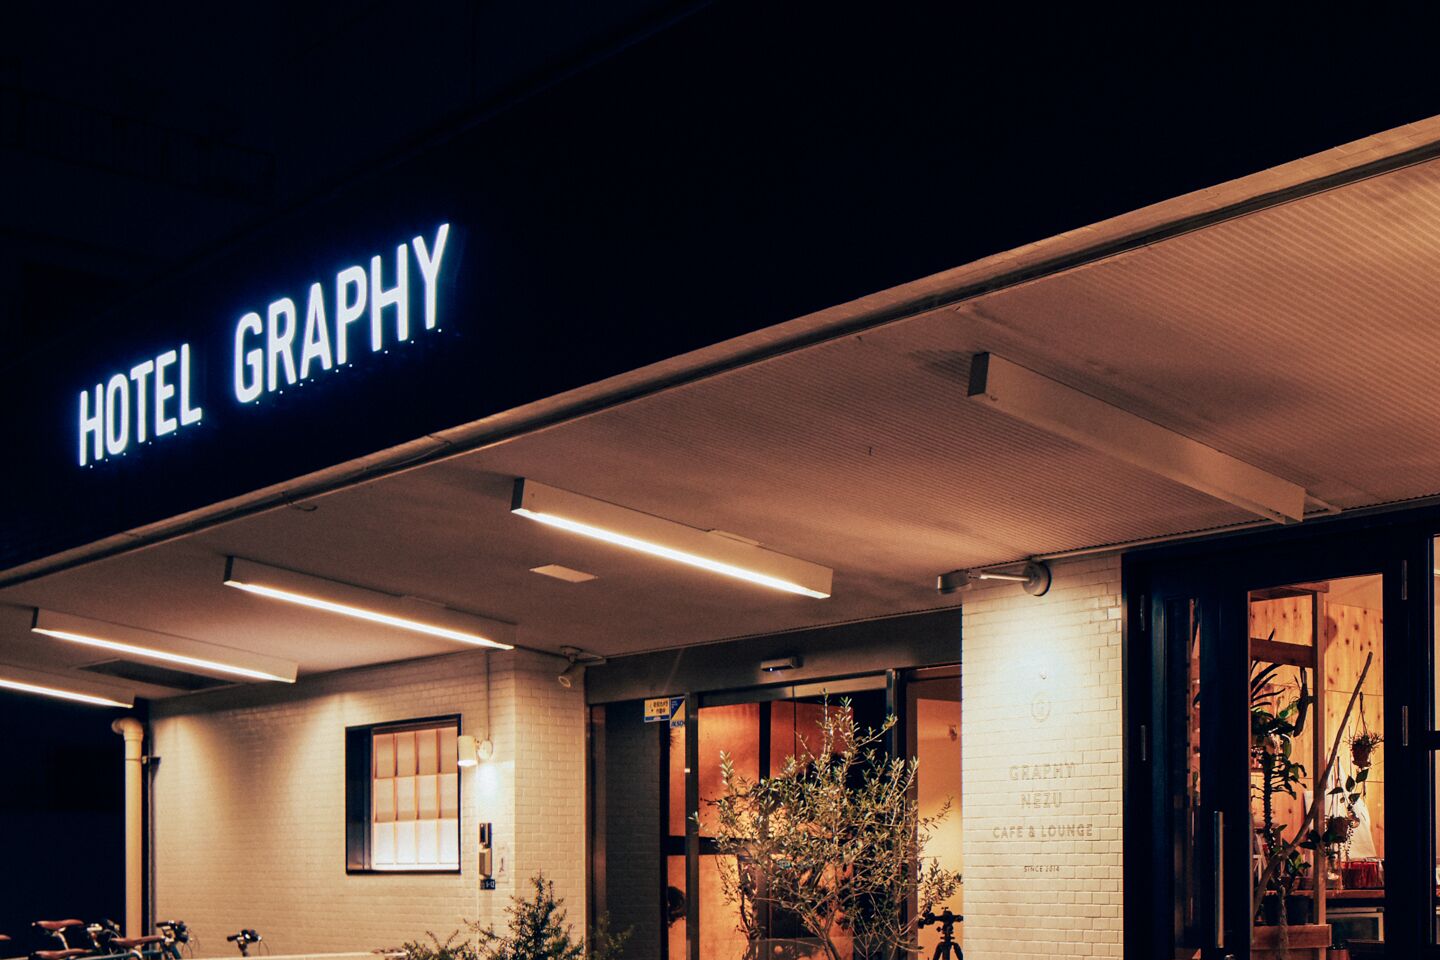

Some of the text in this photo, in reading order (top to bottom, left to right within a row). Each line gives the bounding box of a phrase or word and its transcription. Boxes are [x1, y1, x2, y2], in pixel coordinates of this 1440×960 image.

[79, 223, 450, 466] HOTEL GRAPHY
[1009, 762, 1075, 781] GRAPHY
[1021, 792, 1062, 809] NEZU
[992, 824, 1093, 839] CAFE & LOUNGE
[1024, 865, 1043, 873] SINCE
